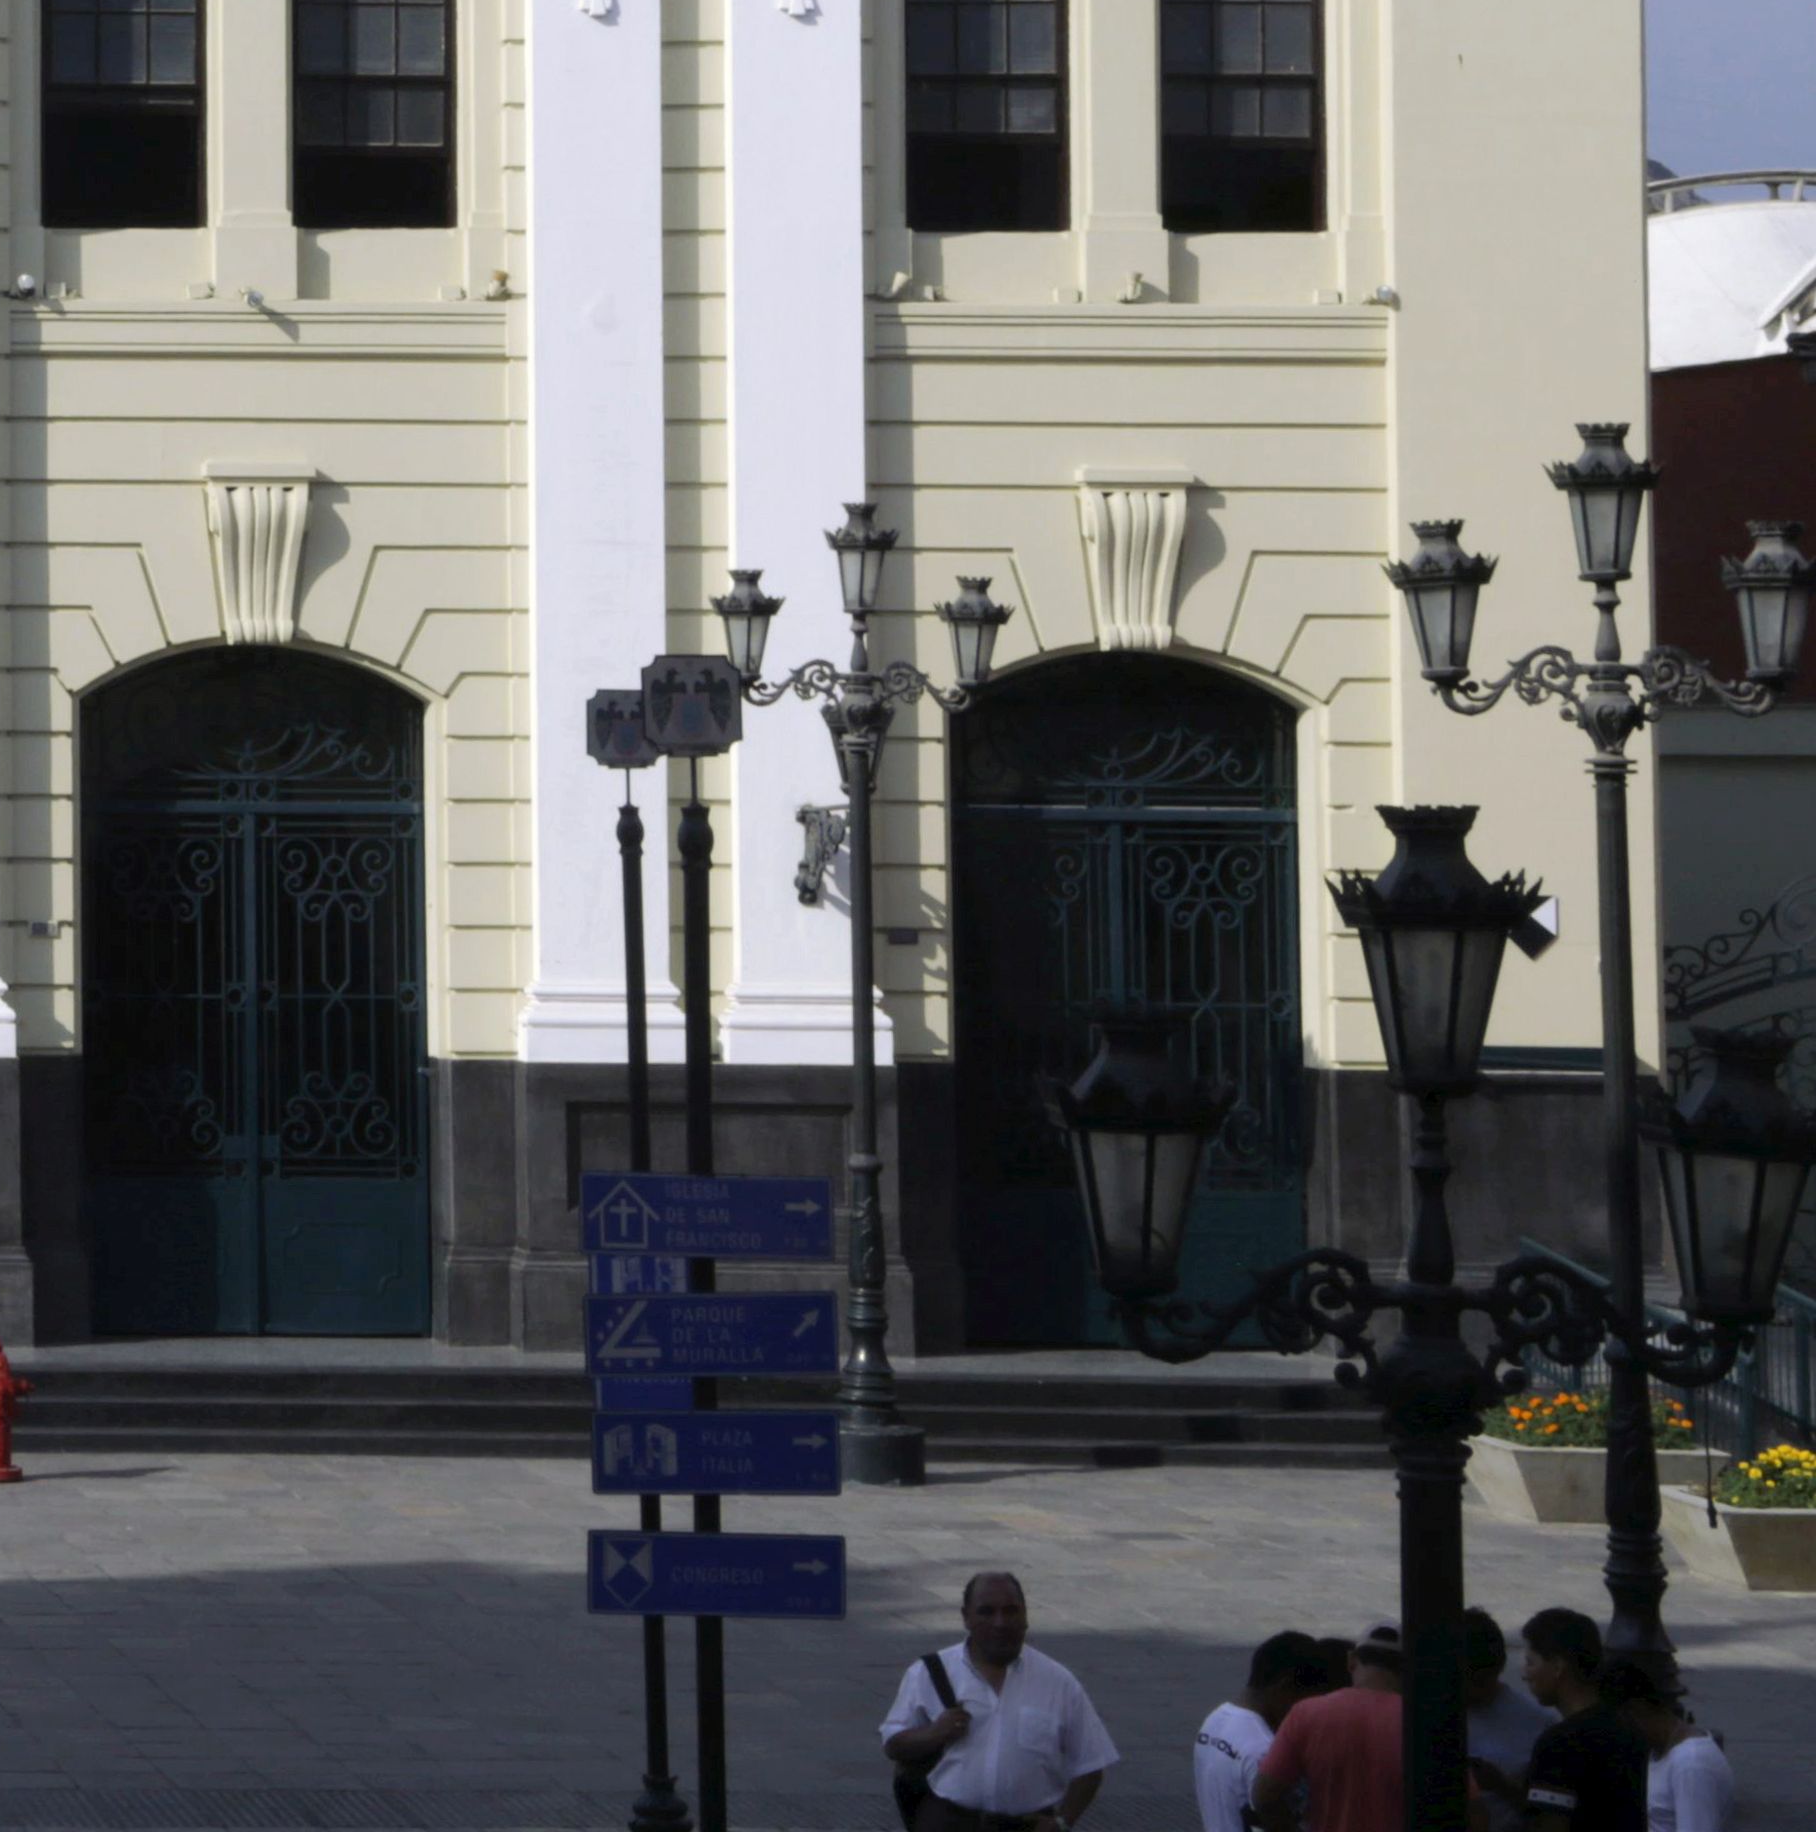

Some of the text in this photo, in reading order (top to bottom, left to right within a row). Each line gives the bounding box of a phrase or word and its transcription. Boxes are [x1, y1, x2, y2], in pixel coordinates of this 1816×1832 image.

[665, 1183, 730, 1199] IGLESIA
[665, 1208, 730, 1225] DE SAN
[666, 1231, 762, 1249] FRANCISCO
[672, 1307, 746, 1323] PARQUE
[672, 1327, 732, 1343] DE LA
[672, 1347, 764, 1364] MURALLA
[702, 1431, 752, 1447] PLAZA
[702, 1458, 753, 1474] ITALIA
[672, 1566, 763, 1585] CONGRESO
